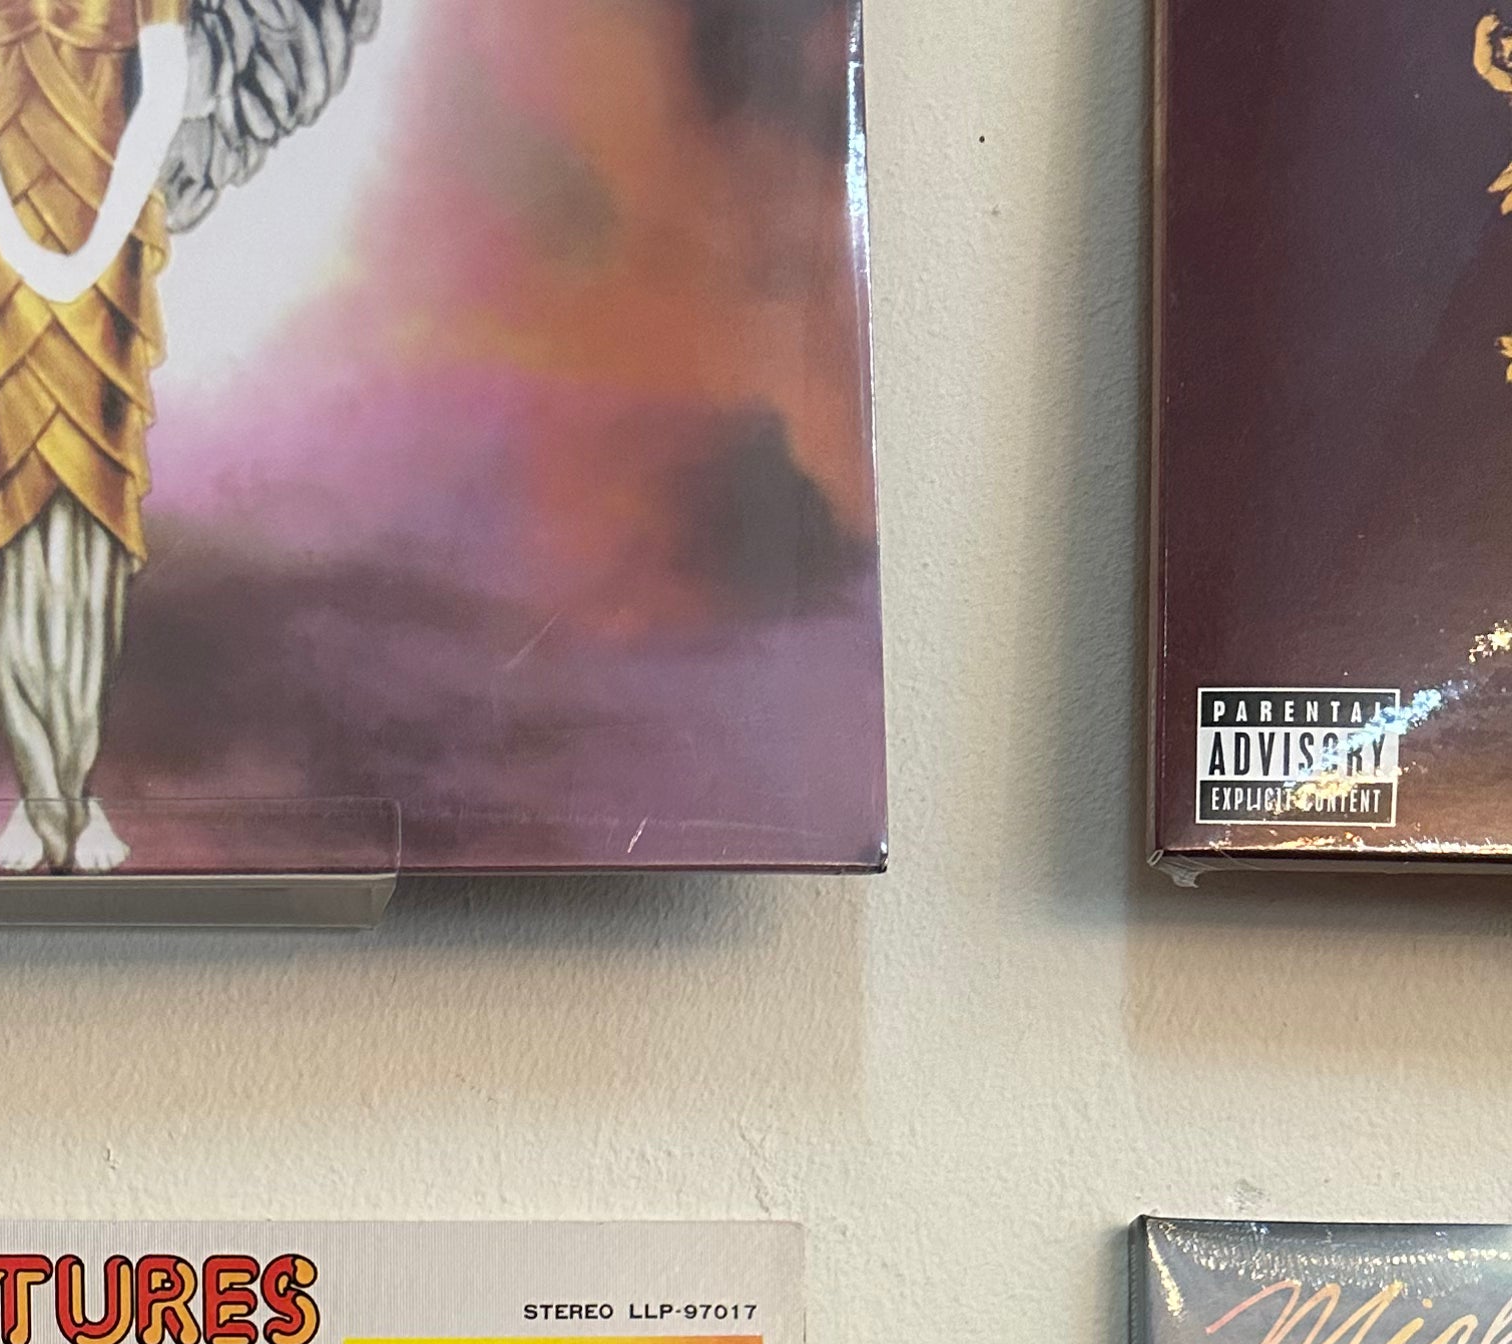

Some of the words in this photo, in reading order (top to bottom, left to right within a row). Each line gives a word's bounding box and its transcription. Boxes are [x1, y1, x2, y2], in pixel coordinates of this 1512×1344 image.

[1213, 700, 1384, 723] PARENTAL
[1211, 787, 1293, 812] EXPLICIT
[523, 1304, 614, 1320] STEREO
[629, 1304, 757, 1320] LLP-97017
